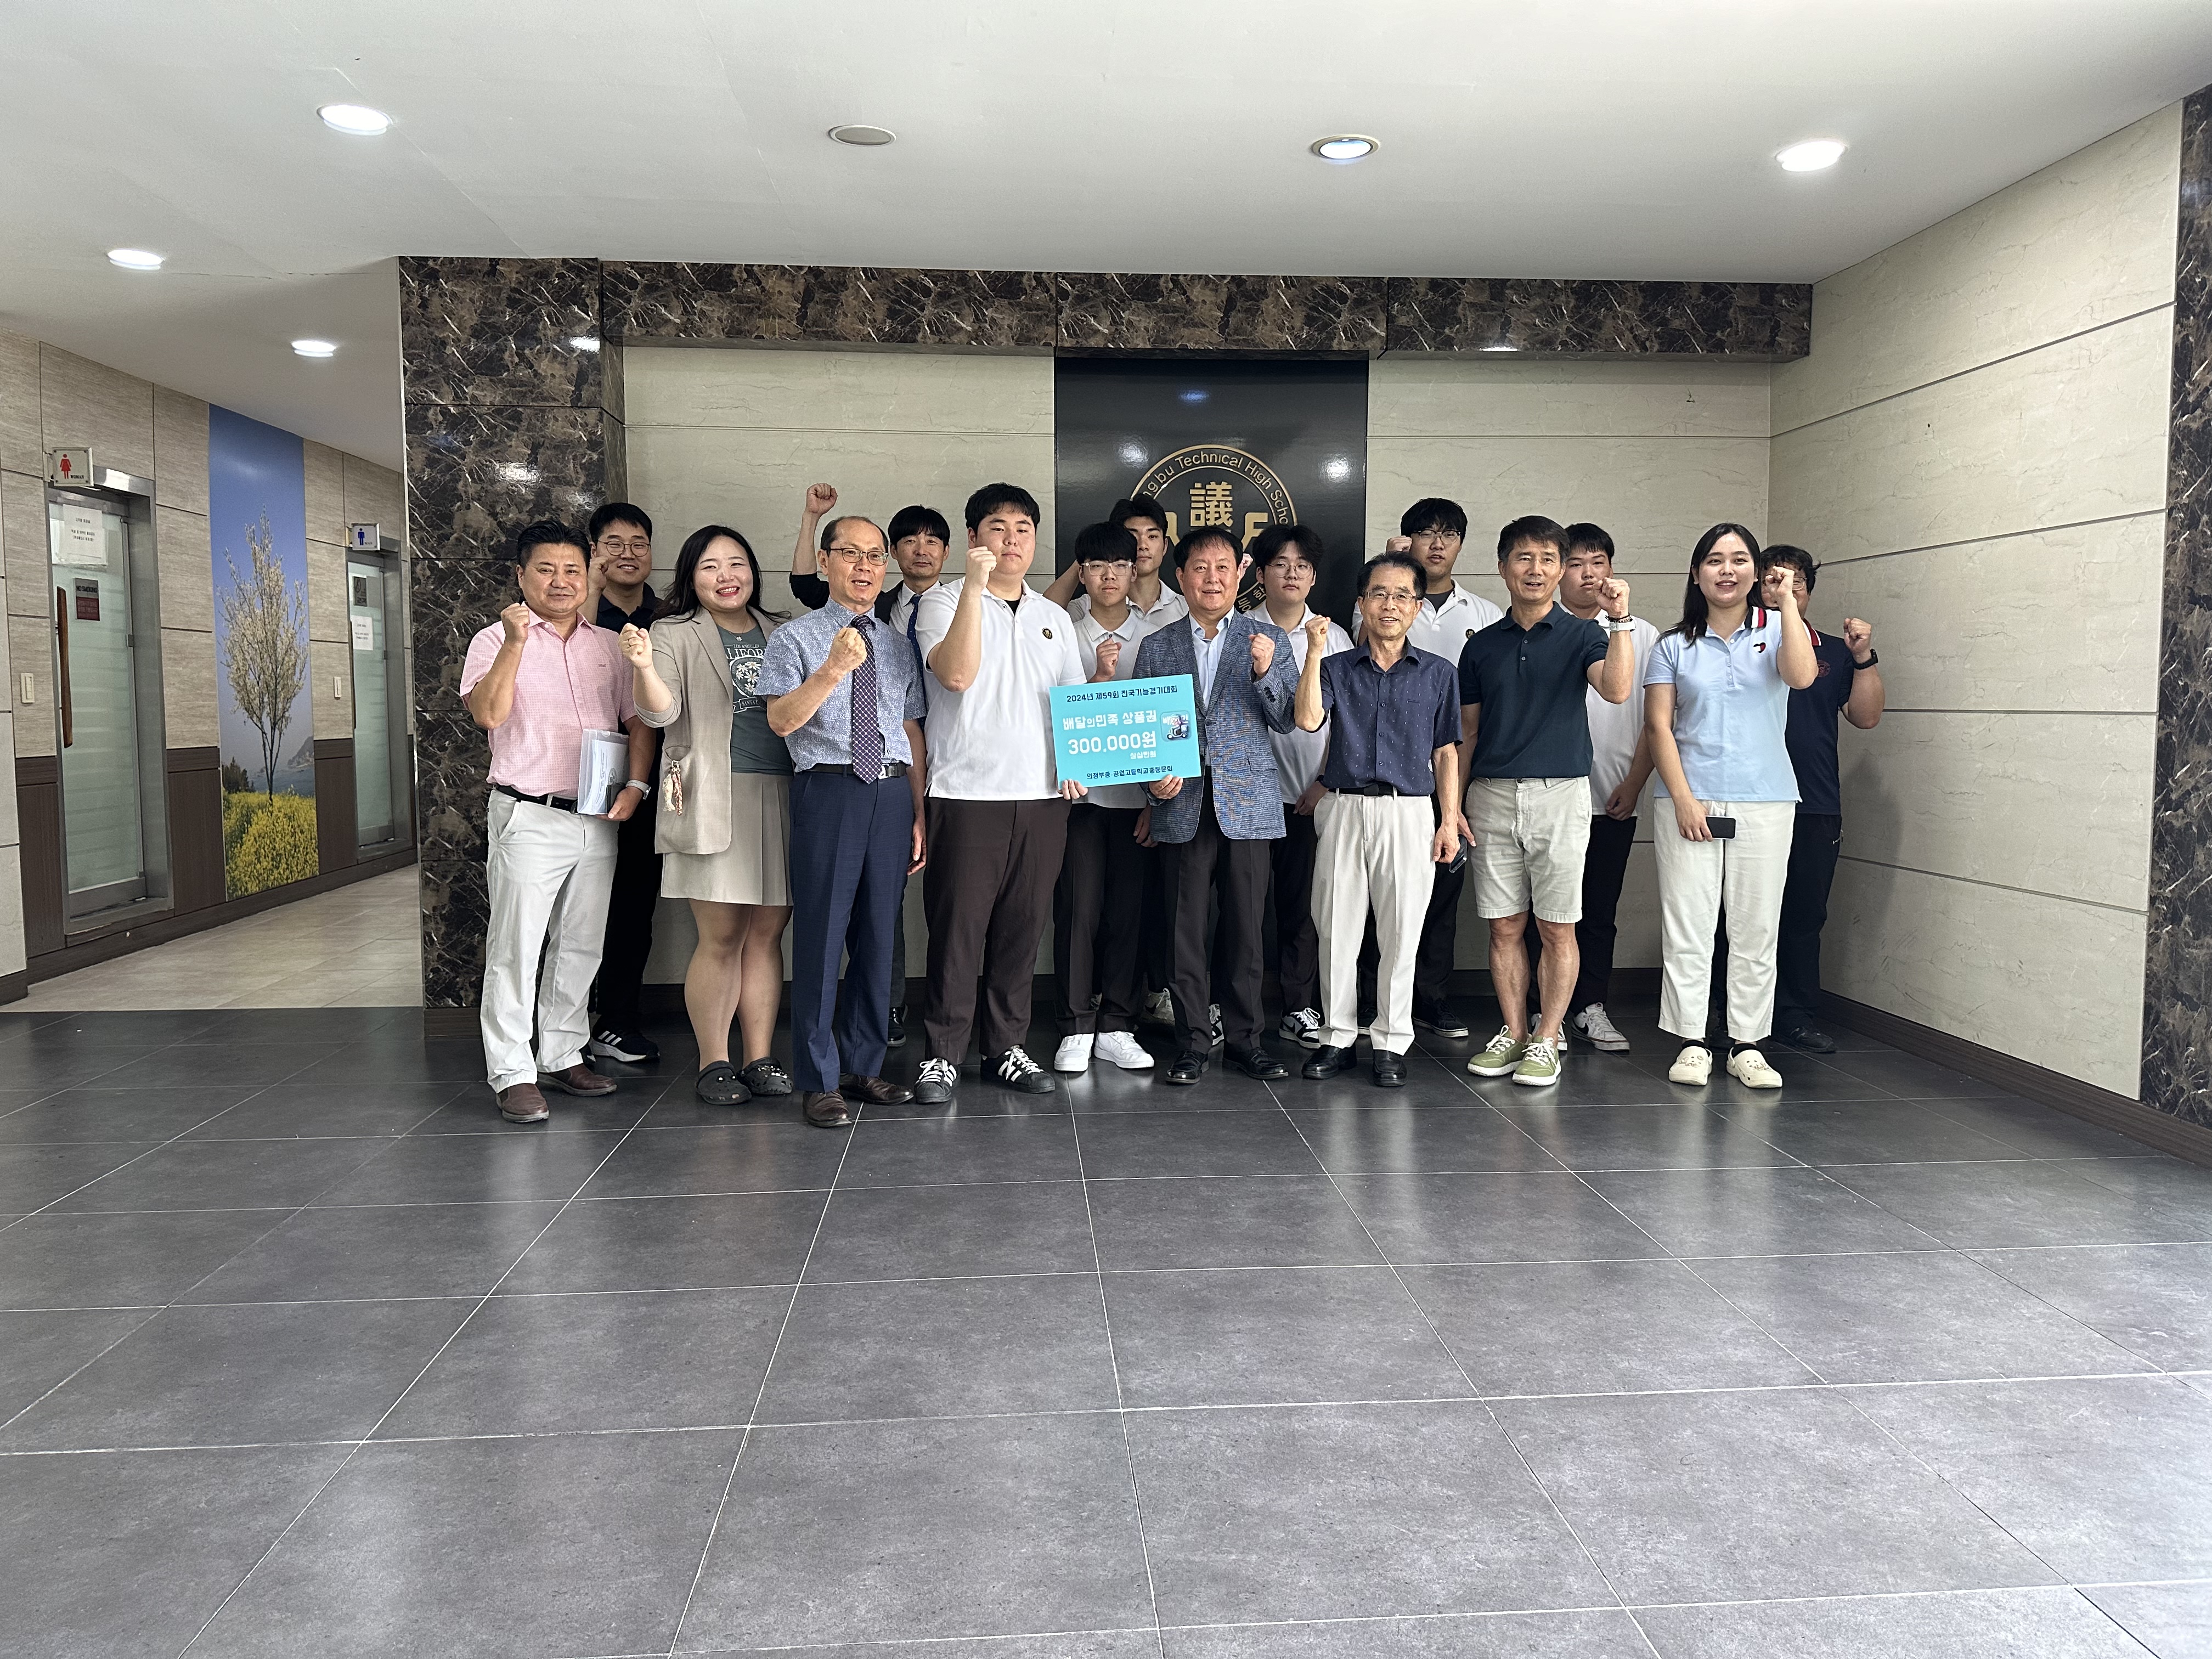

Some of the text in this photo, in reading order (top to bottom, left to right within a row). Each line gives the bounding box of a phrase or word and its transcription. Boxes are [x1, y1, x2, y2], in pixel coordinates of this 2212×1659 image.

[1175, 451, 1243, 469] Technical
[1245, 461, 1272, 490] High
[1270, 489, 1289, 524] Scho
[1189, 481, 1233, 527] 議
[725, 648, 766, 659] LIFOR
[1066, 685, 1177, 702] 2024년 제59회 전국기능경기대회
[1063, 709, 1156, 730] 배달의민족 상품권
[1130, 750, 1156, 760] 삼십만원
